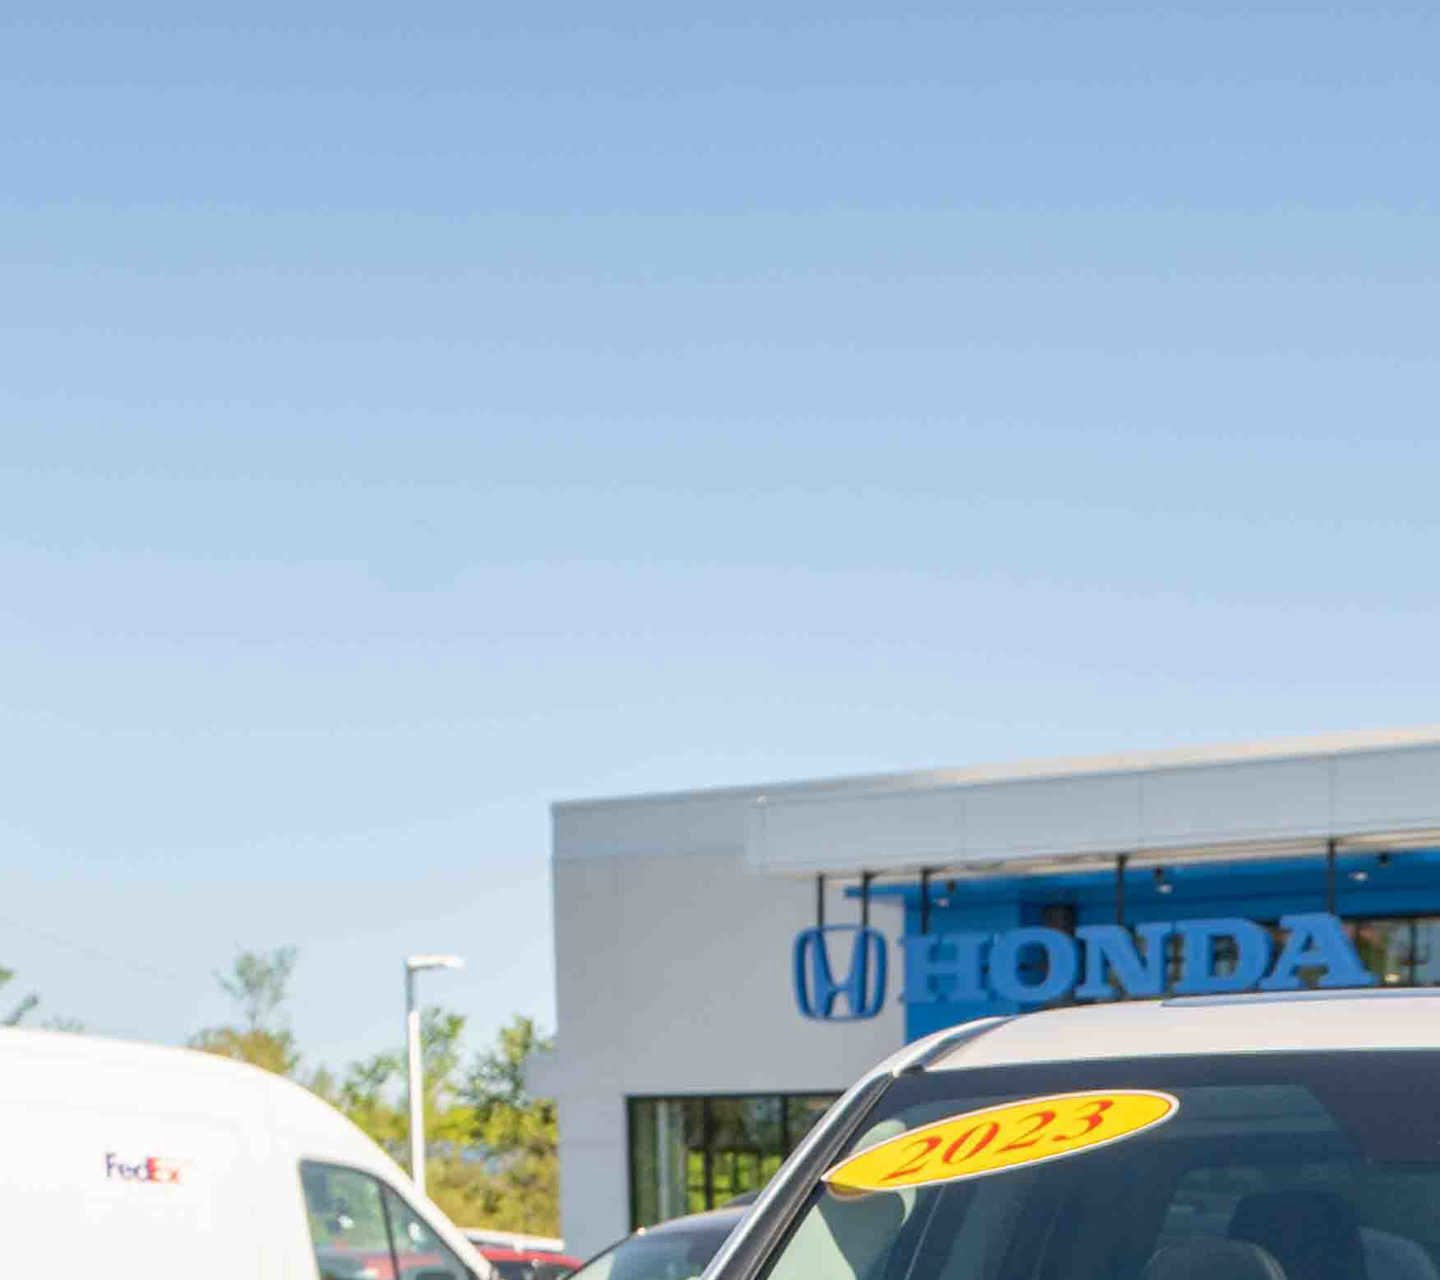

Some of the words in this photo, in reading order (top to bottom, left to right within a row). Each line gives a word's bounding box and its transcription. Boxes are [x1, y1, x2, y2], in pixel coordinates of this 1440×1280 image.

[900, 911, 1379, 1002] HONDA
[104, 1151, 183, 1185] FedEx
[878, 1099, 1115, 1183] 2023
